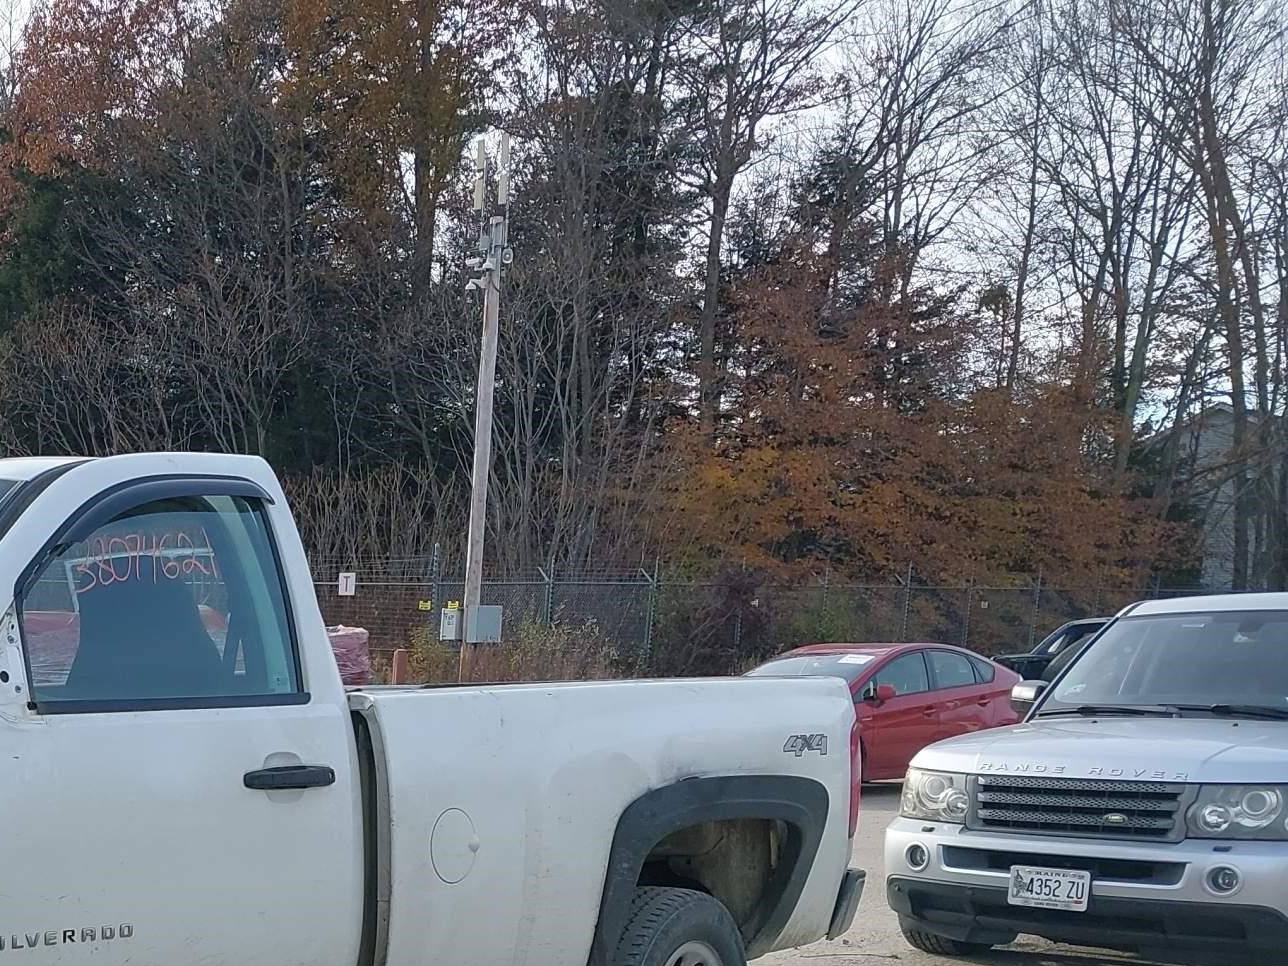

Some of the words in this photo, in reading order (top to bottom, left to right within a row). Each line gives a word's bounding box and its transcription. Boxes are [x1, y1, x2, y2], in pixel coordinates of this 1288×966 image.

[74, 527, 218, 593] 38074621
[979, 762, 1066, 774] RANGE
[1088, 767, 1189, 781] ROVER
[1026, 877, 1061, 897] 4352
[1066, 880, 1085, 899] ZU
